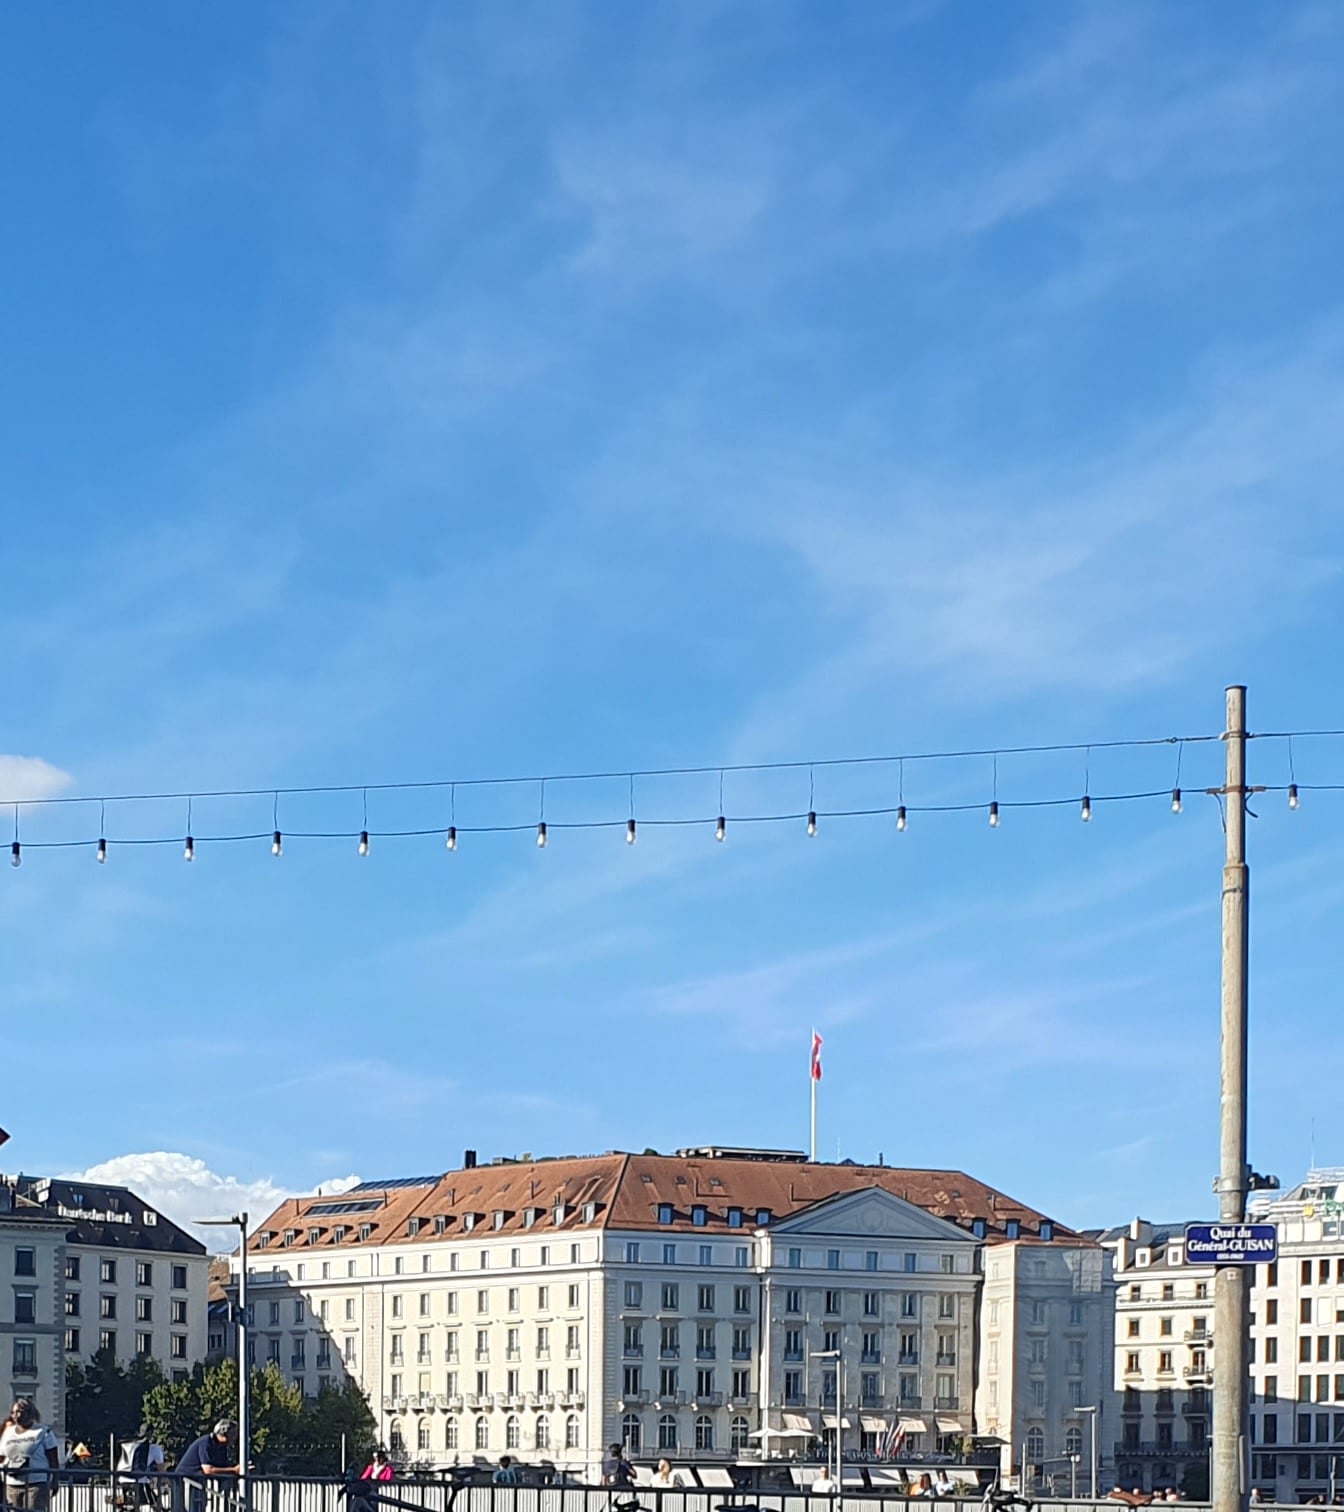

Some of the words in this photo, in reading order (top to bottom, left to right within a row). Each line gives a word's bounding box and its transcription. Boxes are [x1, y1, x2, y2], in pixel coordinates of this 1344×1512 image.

[1210, 1226, 1236, 1241] Quai
[1237, 1226, 1252, 1238] du
[1187, 1239, 1274, 1251] Général-GUISAN
